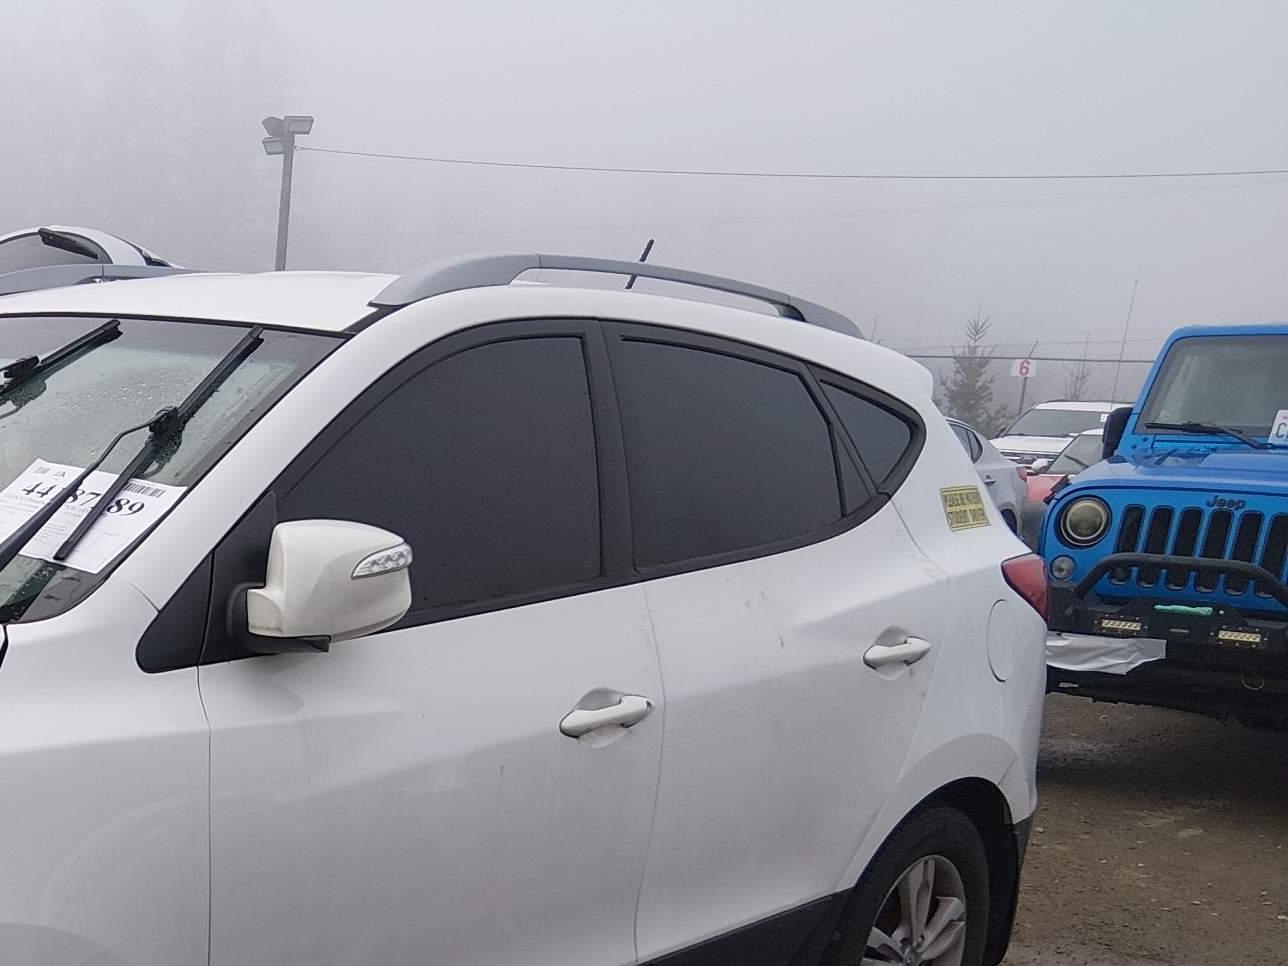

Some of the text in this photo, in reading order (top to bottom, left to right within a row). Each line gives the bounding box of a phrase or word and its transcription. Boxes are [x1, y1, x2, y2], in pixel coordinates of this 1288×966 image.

[1018, 359, 1030, 376] 6
[21, 481, 146, 516] 448789
[1206, 495, 1246, 511] Jeep
